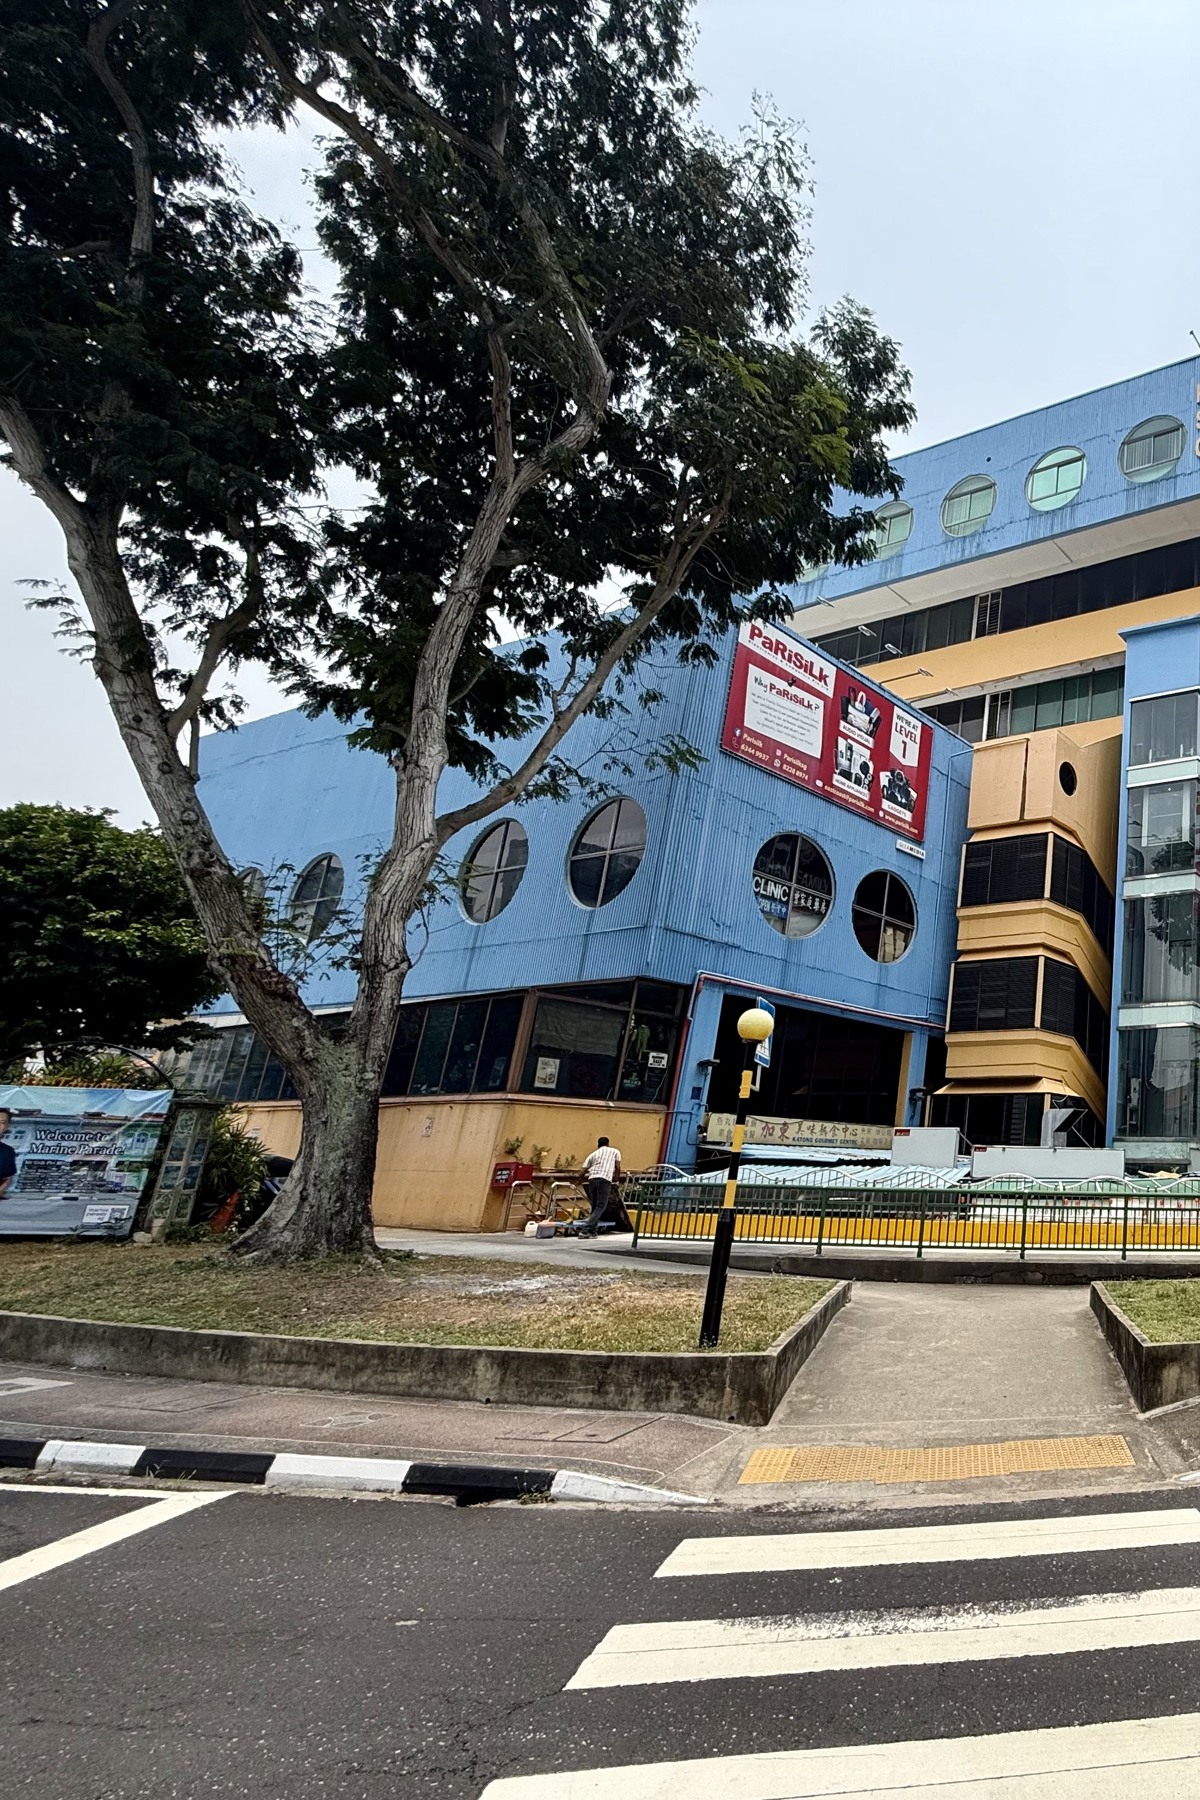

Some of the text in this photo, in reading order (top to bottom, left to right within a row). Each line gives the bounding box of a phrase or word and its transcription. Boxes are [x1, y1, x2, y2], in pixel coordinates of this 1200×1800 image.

[896, 713, 911, 728] WE'RE
[895, 722, 918, 744] LEVEL
[741, 744, 769, 761] 6344 9937
[902, 740, 907, 759] 1
[887, 804, 907, 817] GADGETS
[753, 876, 789, 902] CLINIC
[35, 1130, 110, 1141] Welcome to
[29, 1143, 126, 1155] Marine Parade!
